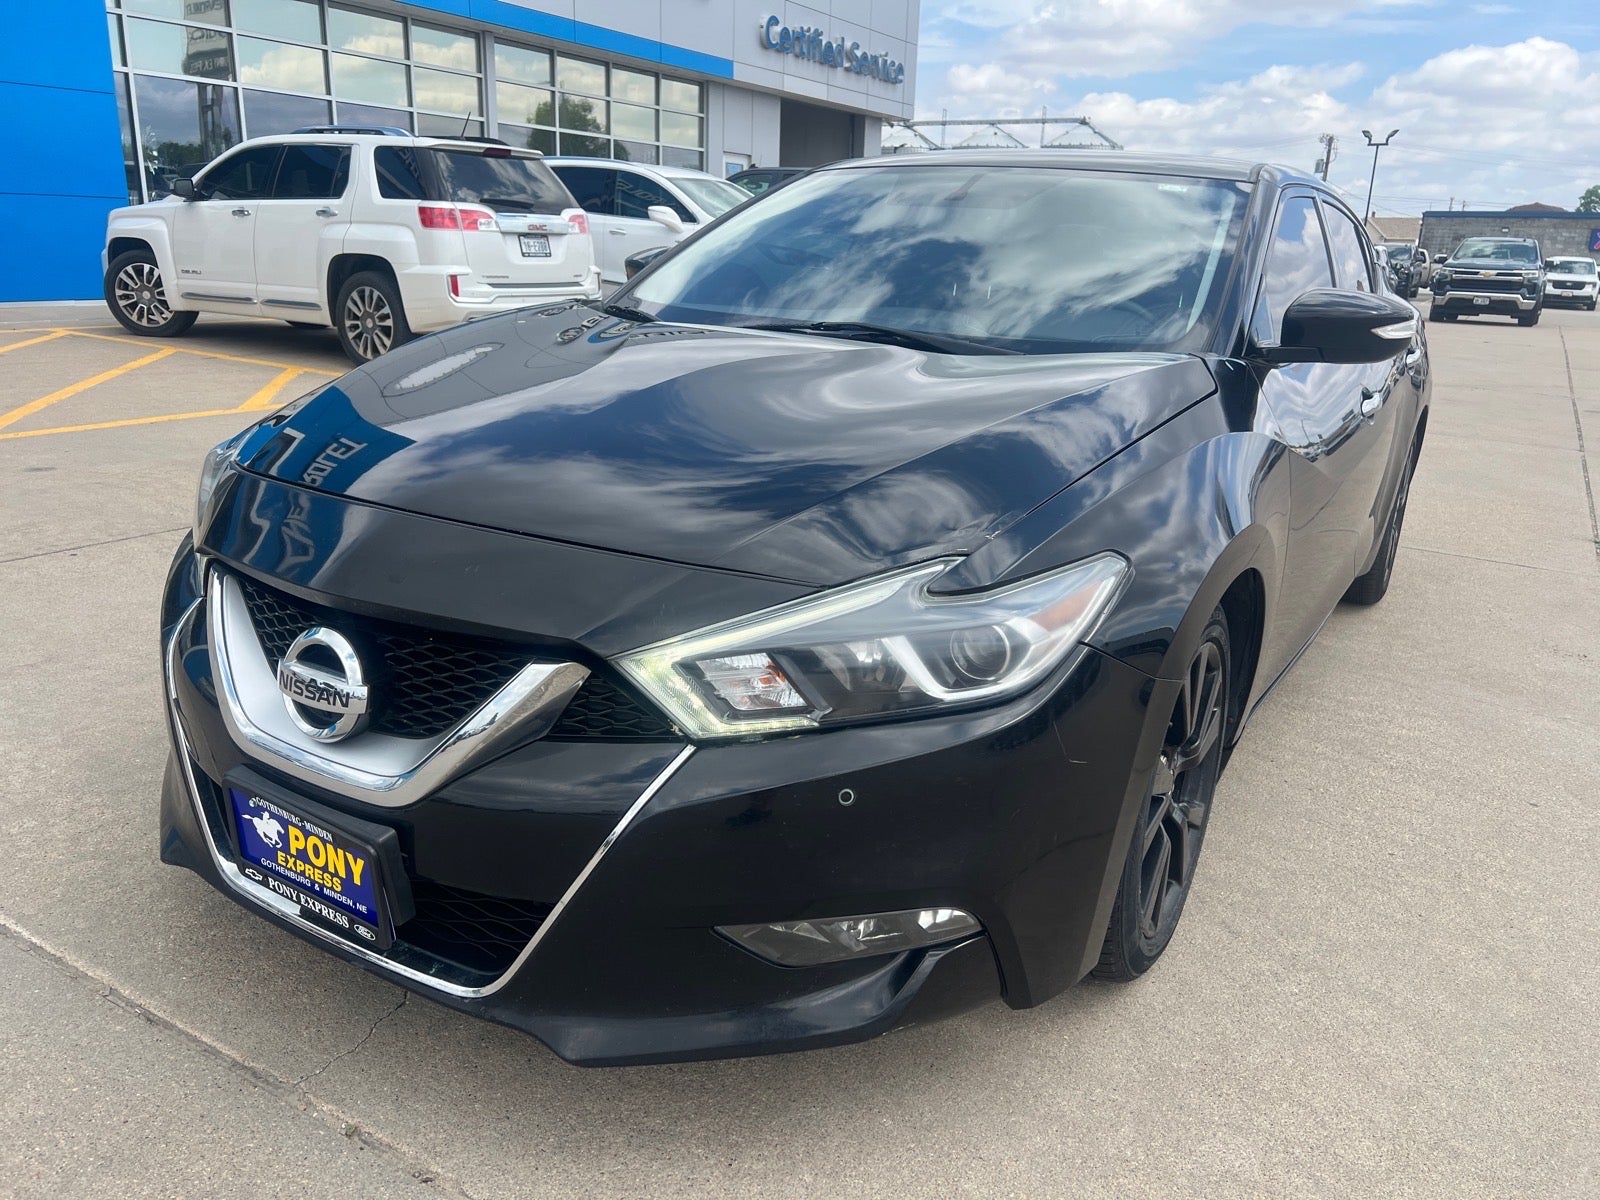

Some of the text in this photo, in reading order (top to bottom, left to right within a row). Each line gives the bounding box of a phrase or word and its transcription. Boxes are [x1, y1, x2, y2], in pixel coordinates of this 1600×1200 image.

[763, 15, 904, 84] Certified Service
[280, 670, 350, 708] NISSAN
[277, 850, 342, 892] EXPRESS
[288, 824, 365, 886] PONY
[261, 858, 367, 914] GOTHENBURG & MINDEN, NE
[267, 877, 350, 928] PONY EXPRESS
